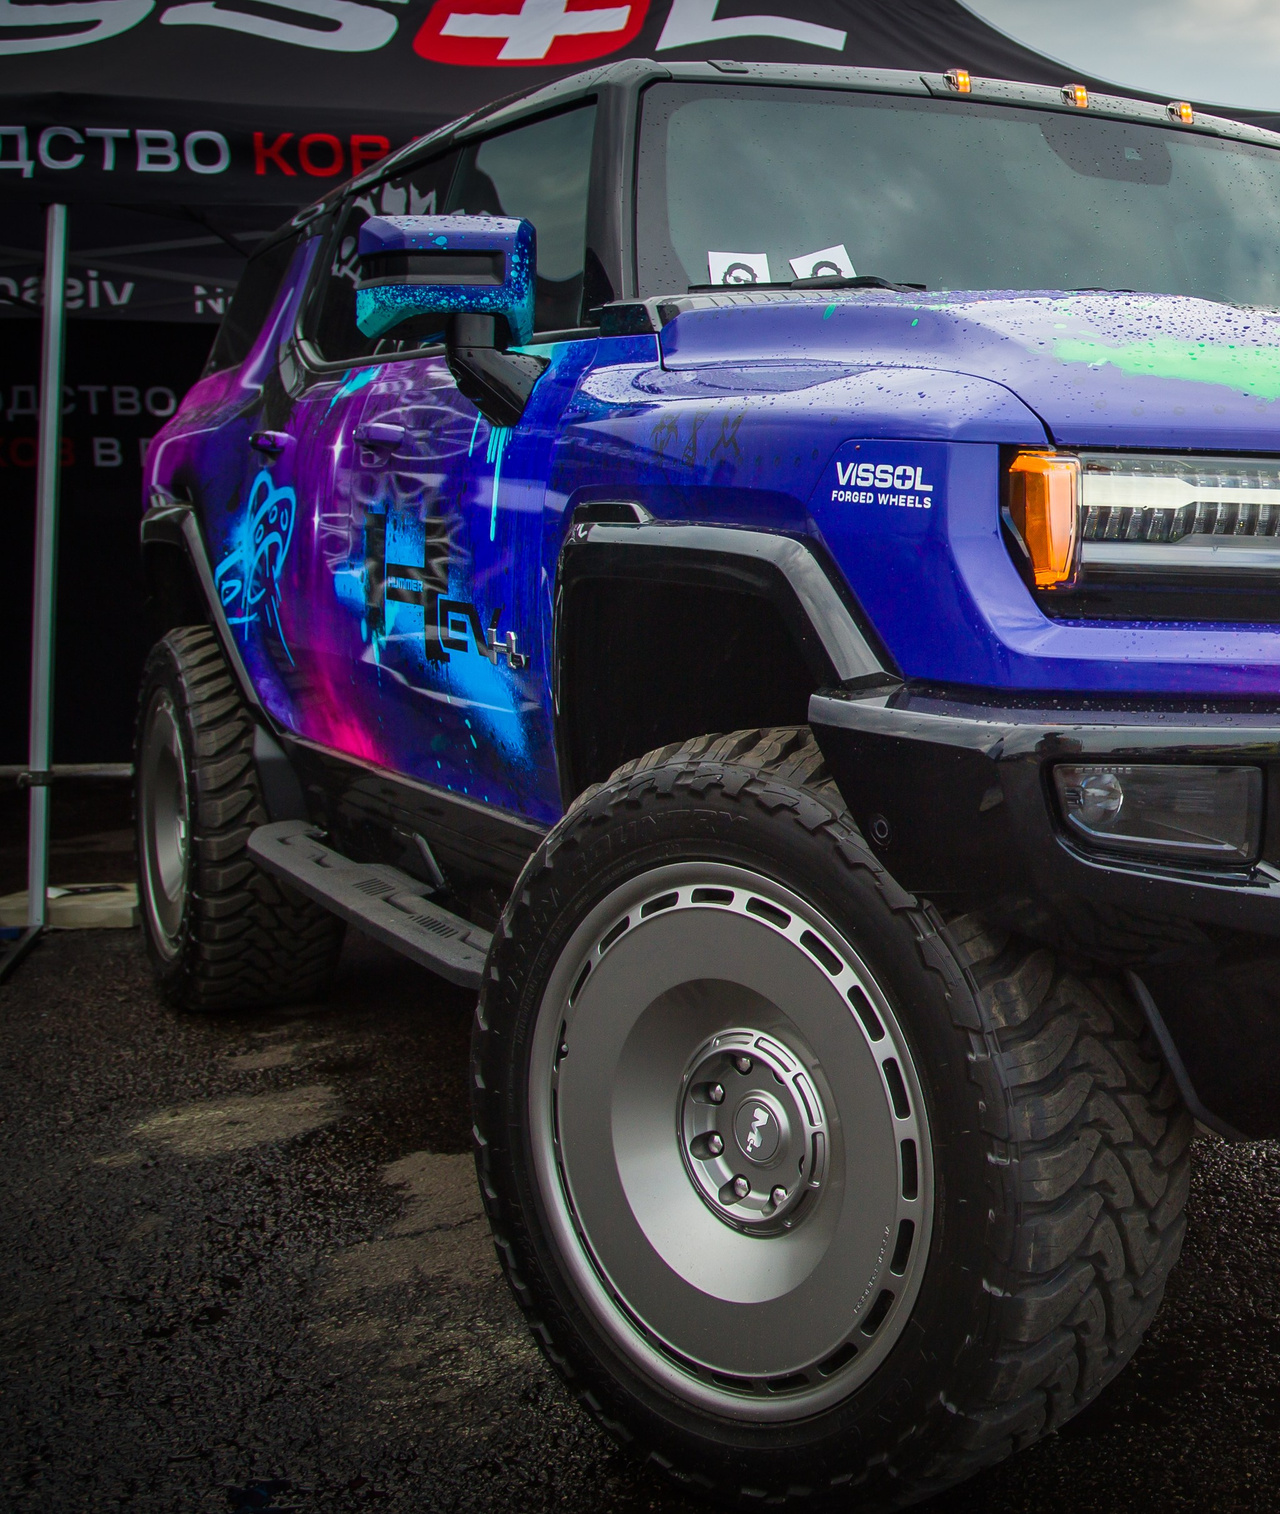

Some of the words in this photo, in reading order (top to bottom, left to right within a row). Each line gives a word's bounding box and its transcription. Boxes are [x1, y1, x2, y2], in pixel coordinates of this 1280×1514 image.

[836, 461, 934, 492] VISSOL
[831, 490, 874, 504] FORGED
[878, 493, 932, 509] WHEELS
[387, 576, 424, 592] HUMMER
